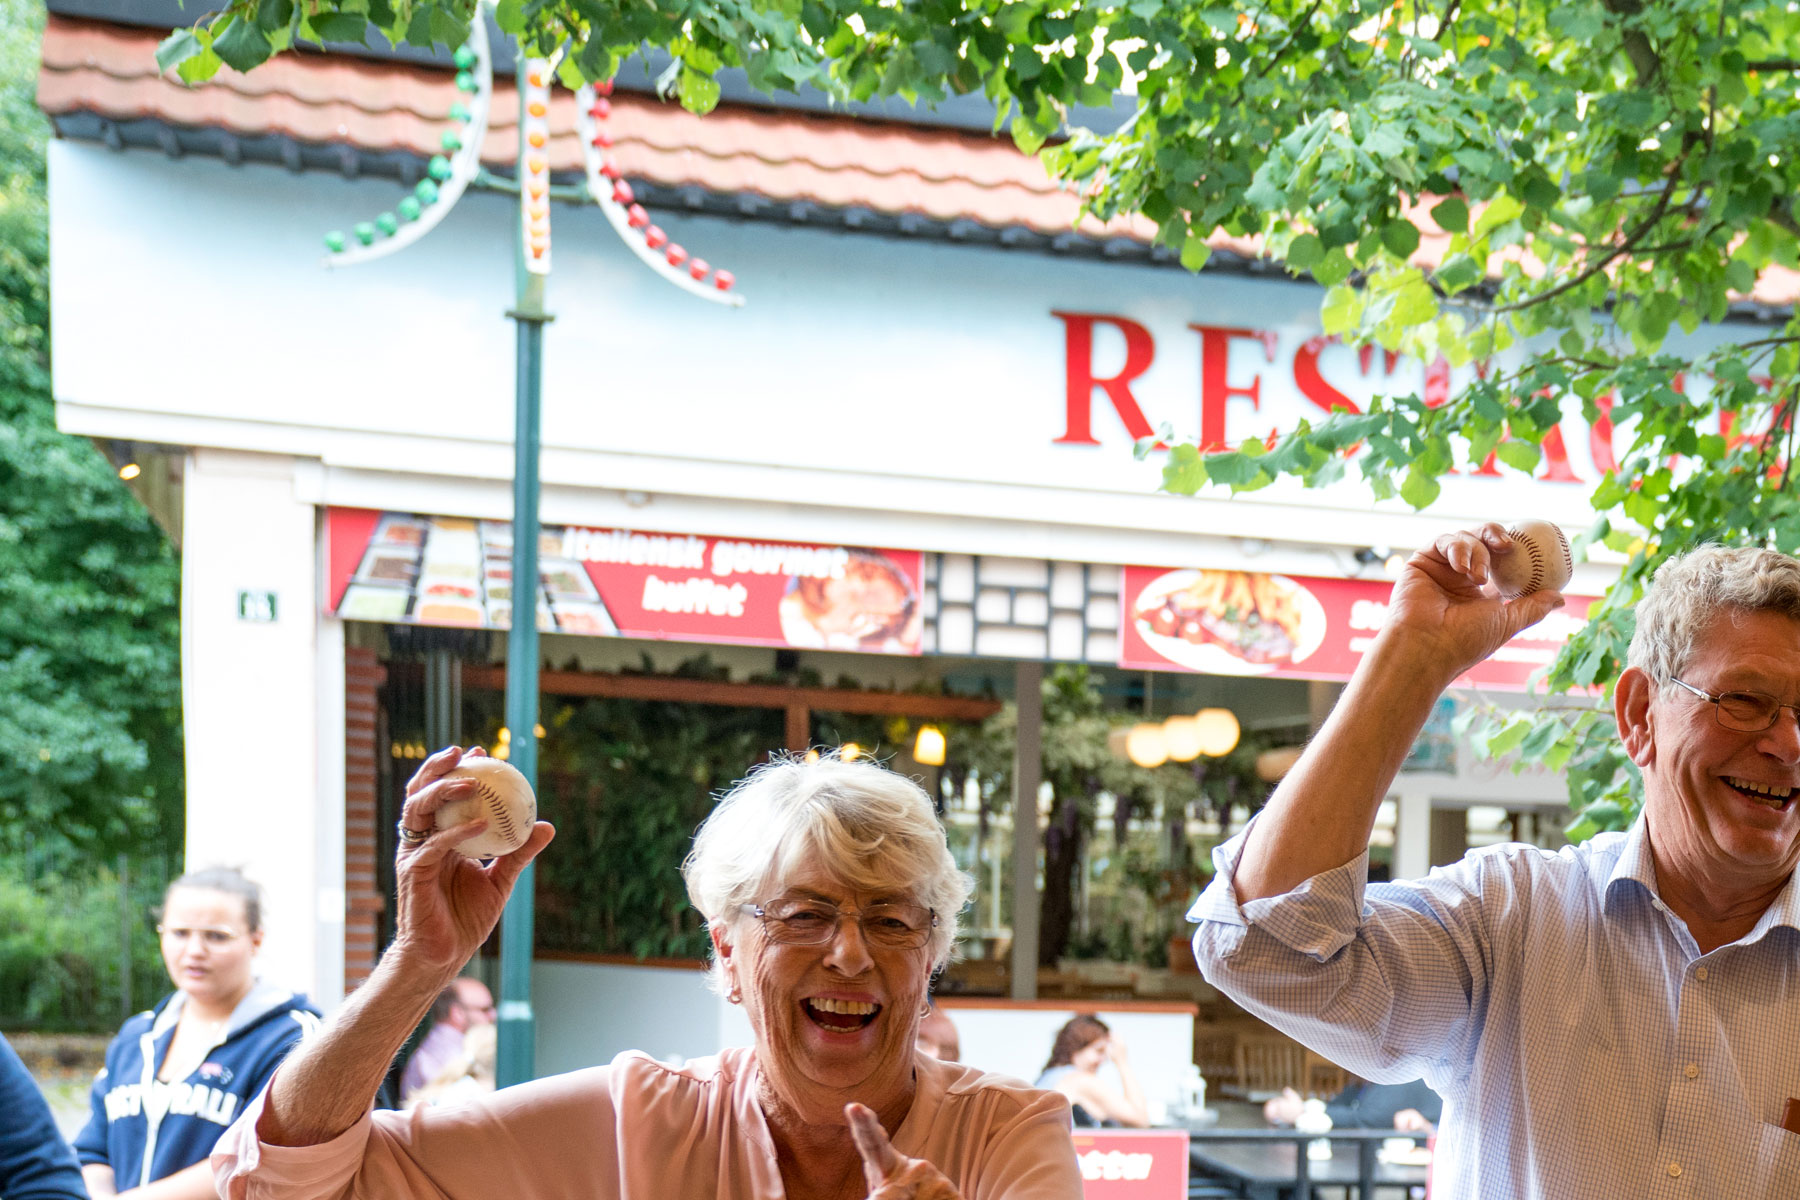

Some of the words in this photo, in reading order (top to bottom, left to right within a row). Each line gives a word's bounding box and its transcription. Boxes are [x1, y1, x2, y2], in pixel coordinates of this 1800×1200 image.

[562, 526, 706, 569] Italiensk
[711, 540, 849, 579] gourmet
[642, 574, 748, 617] buffet
